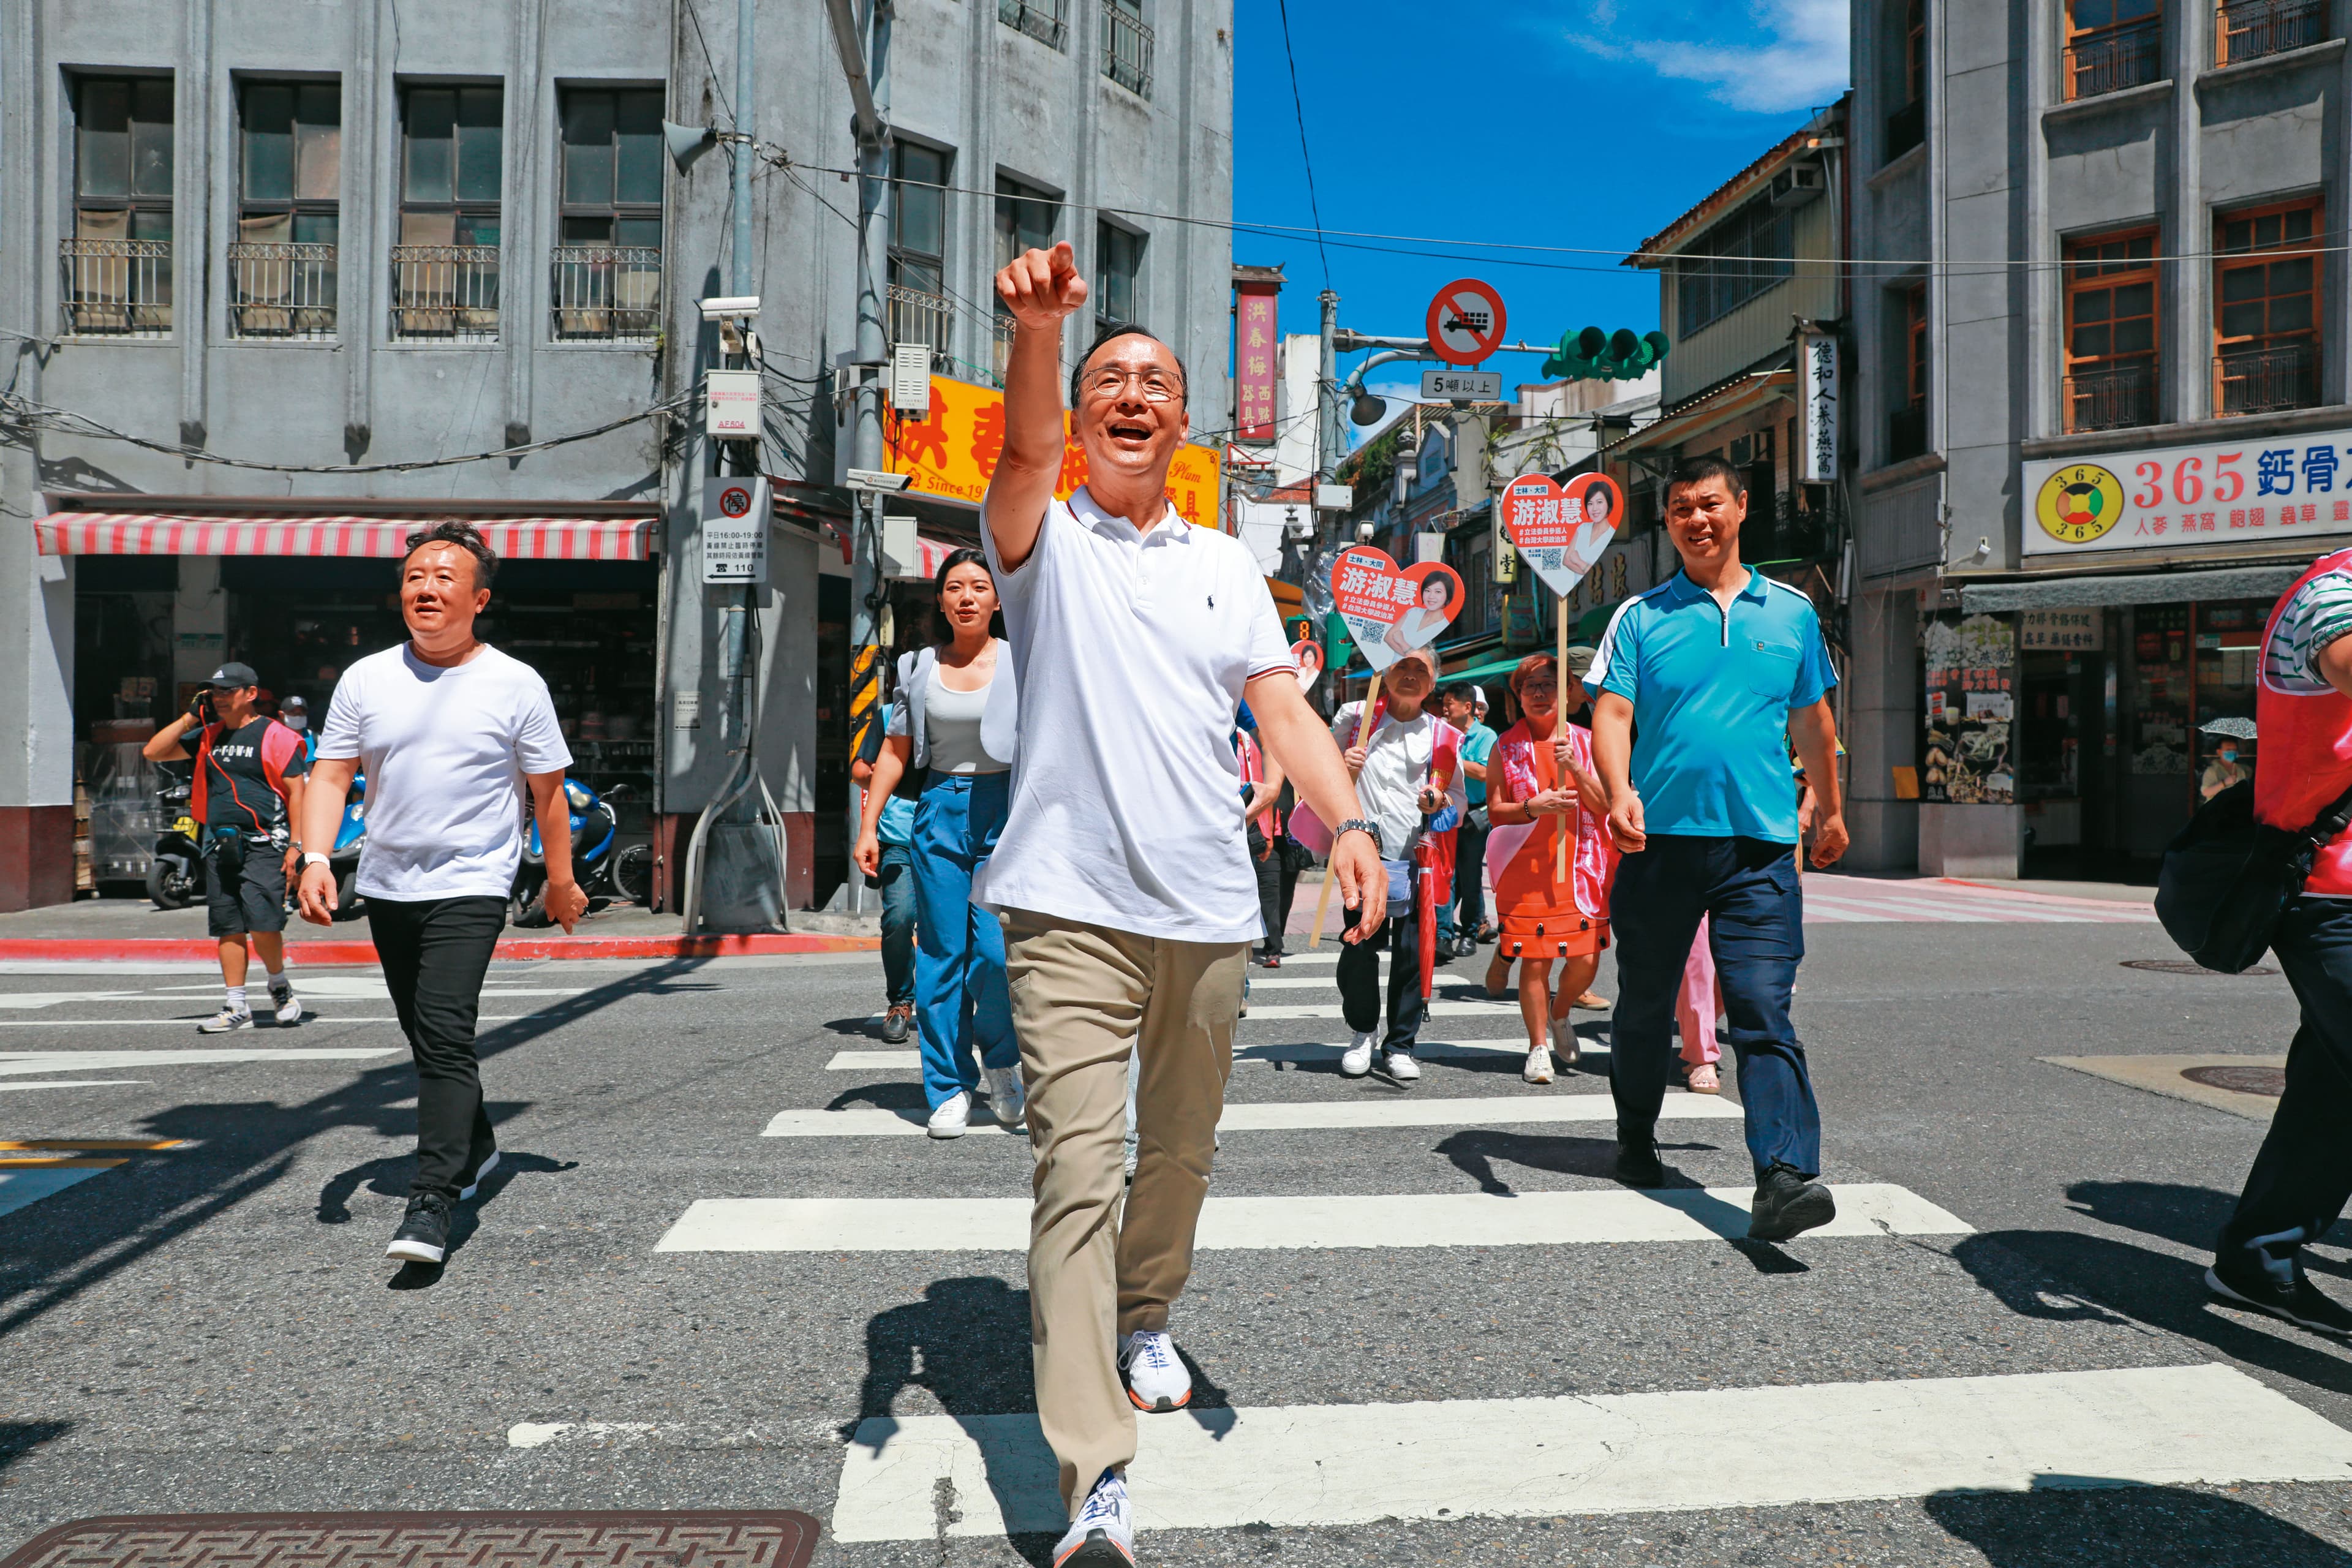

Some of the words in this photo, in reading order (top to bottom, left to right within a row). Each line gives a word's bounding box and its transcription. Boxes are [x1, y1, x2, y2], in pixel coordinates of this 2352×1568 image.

[1247, 302, 1267, 377] 洪春梅
[1434, 377, 1491, 393] 5噸以上
[1242, 384, 1255, 424] 器具
[1258, 385, 1272, 423] 西點
[1169, 461, 1200, 483] Plum
[2055, 469, 2105, 488] 365
[2134, 451, 2244, 508] 365
[927, 477, 963, 495] Since
[1512, 497, 1582, 526] 游淑慧
[2182, 512, 2215, 533] 燕窩
[2280, 503, 2317, 526] 蟲草
[2056, 520, 2103, 538] 365
[735, 564, 754, 572] 110
[1339, 566, 1419, 606] 游淑慧
[1299, 620, 1310, 640] 8
